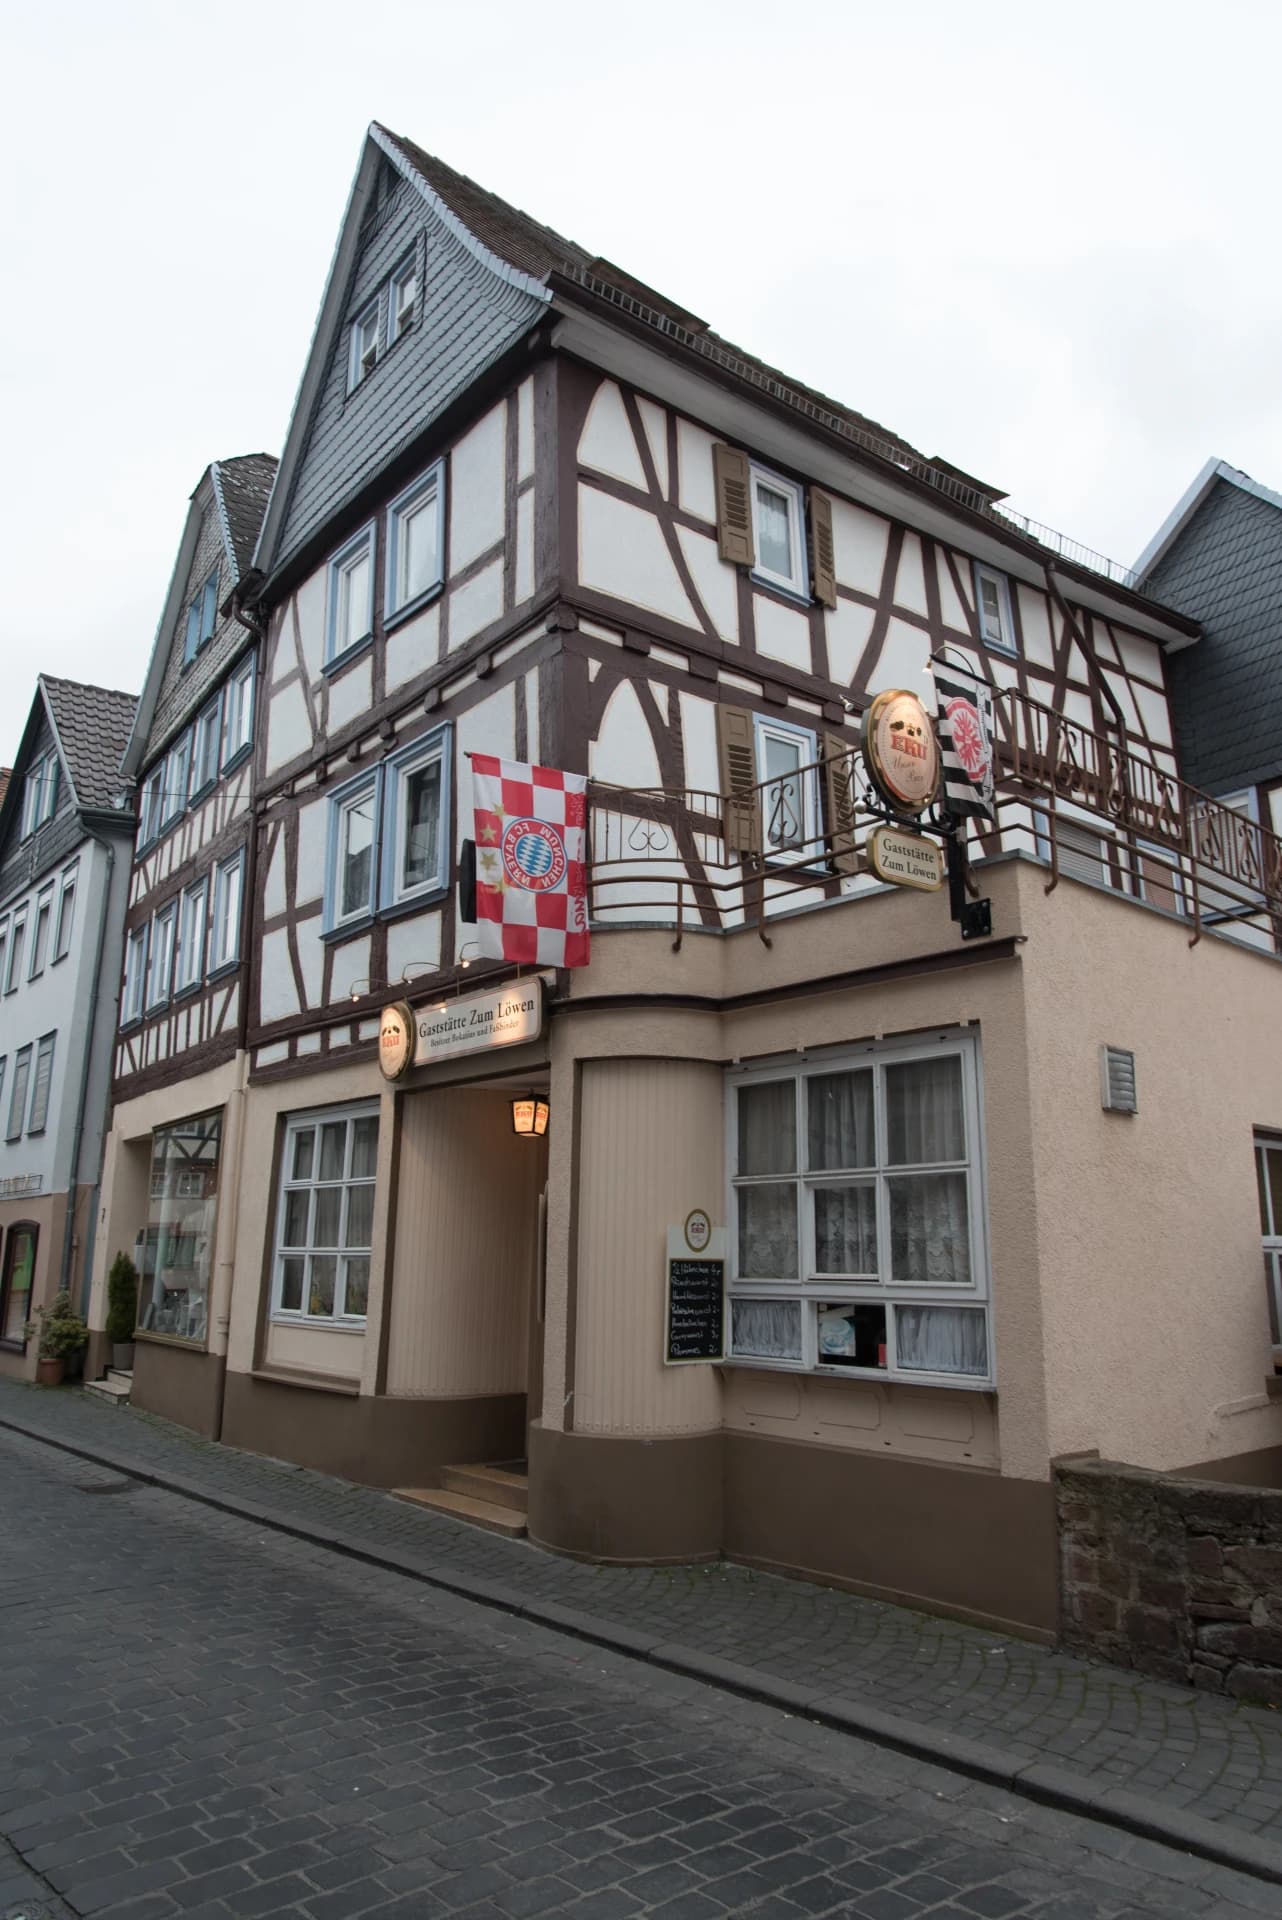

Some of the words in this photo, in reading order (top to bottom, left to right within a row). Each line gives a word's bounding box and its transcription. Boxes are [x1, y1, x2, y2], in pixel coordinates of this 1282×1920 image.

[891, 735, 928, 760] EKU
[883, 838, 935, 863] Gaststätte
[881, 855, 905, 872] Zum
[906, 861, 937, 881] Löwen
[419, 1014, 467, 1038] Gaststätte
[470, 1009, 494, 1026] Zum
[498, 999, 535, 1019] Löwen
[477, 1026, 489, 1036] und
